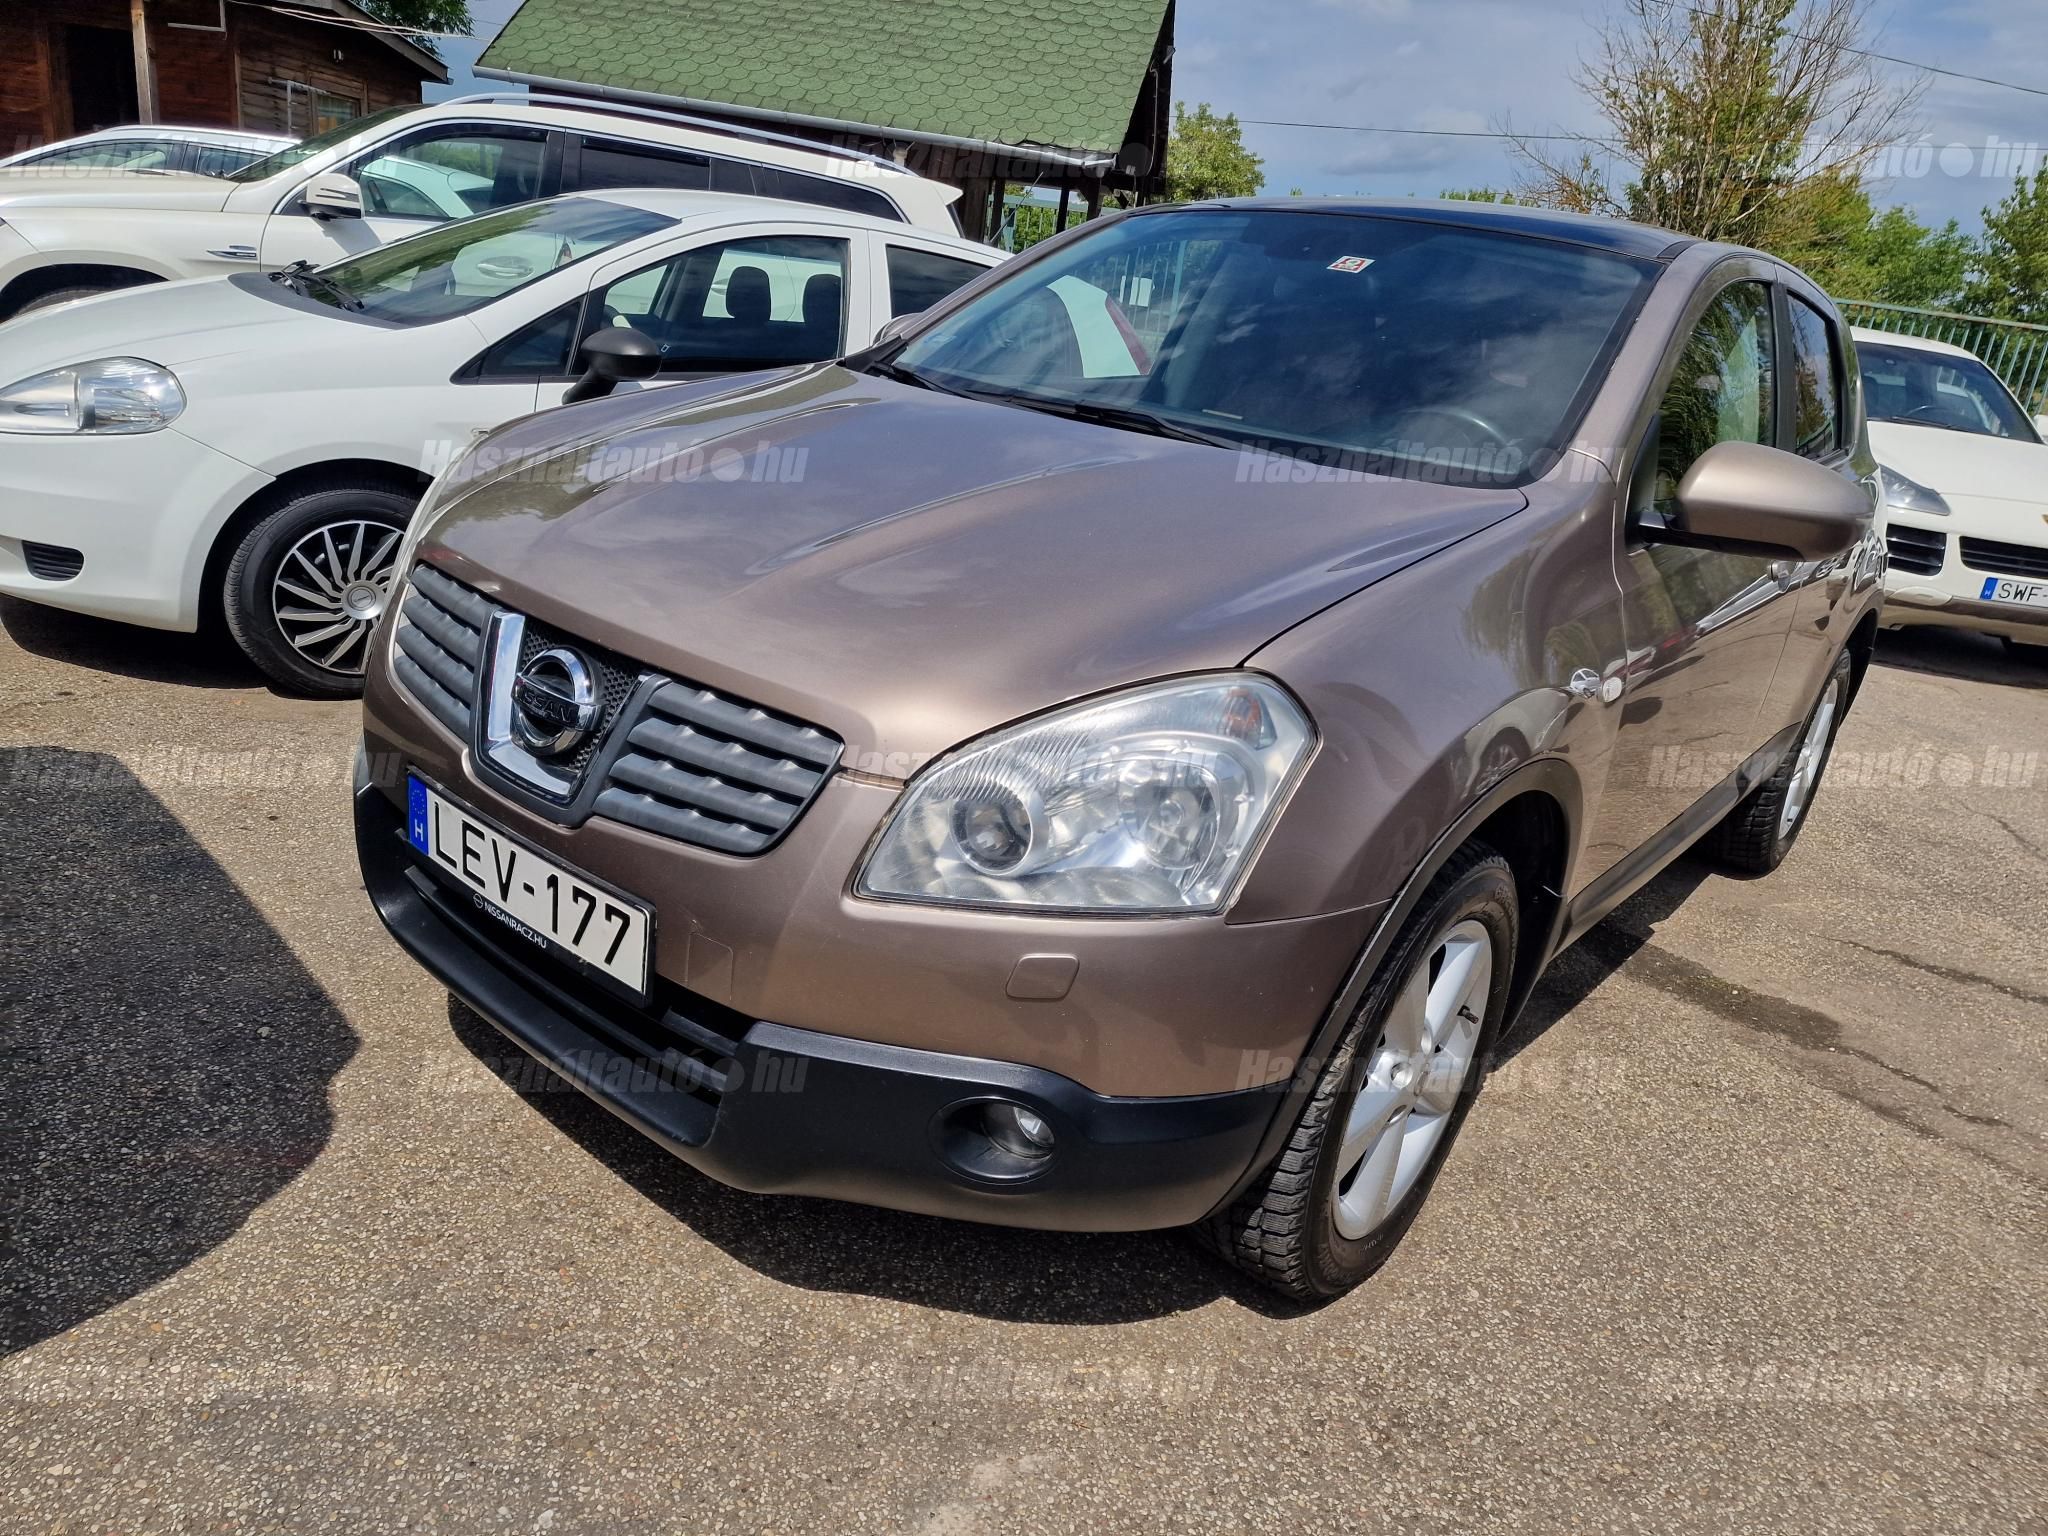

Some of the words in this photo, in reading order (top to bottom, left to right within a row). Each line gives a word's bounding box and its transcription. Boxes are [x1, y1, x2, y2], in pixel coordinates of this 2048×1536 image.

[414, 818, 424, 841] H
[434, 801, 631, 966] LEV-177
[484, 901, 547, 949] NISSANRACZ.HU
